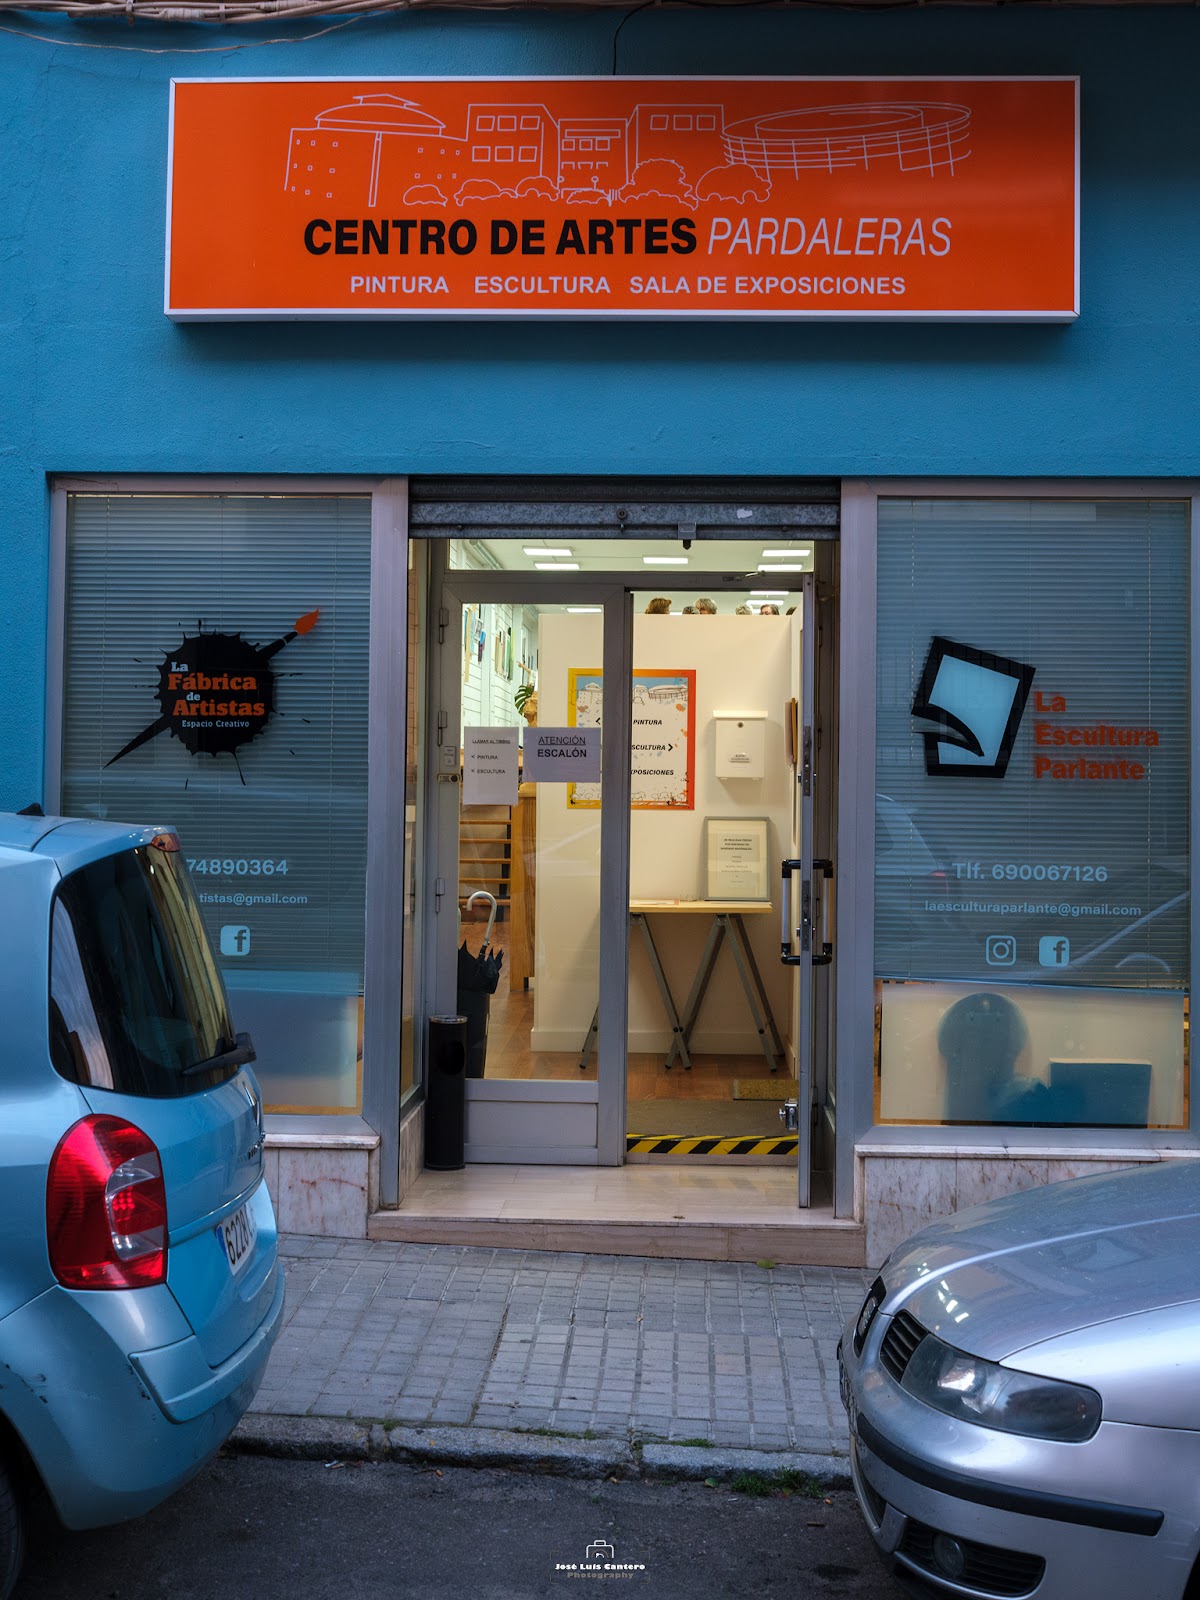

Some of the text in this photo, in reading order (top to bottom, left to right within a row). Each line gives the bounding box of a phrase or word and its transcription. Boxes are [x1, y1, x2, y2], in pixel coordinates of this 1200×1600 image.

[304, 216, 953, 256] CENTRO DE ARTES PARDALERAS
[350, 275, 906, 294] PINTURA ESCULTURA SALA DE EXPOSICIONES
[171, 662, 189, 672] La
[168, 672, 257, 690] Fábrica
[186, 692, 201, 701] de
[1034, 691, 1066, 712] La
[173, 699, 265, 716] Artistas
[182, 720, 250, 728] Espacio Creativo
[538, 735, 586, 746] ATENCIÓN
[1034, 724, 1159, 747] Escultura
[537, 747, 587, 758] ESCALÓN
[1034, 758, 1145, 781] Parlante
[186, 859, 288, 875] 74890364
[952, 863, 1108, 882] Tlf. 690067126
[200, 893, 308, 906] tistas@gmail.com
[925, 901, 1142, 917] laesculturaparlante@gmail.com
